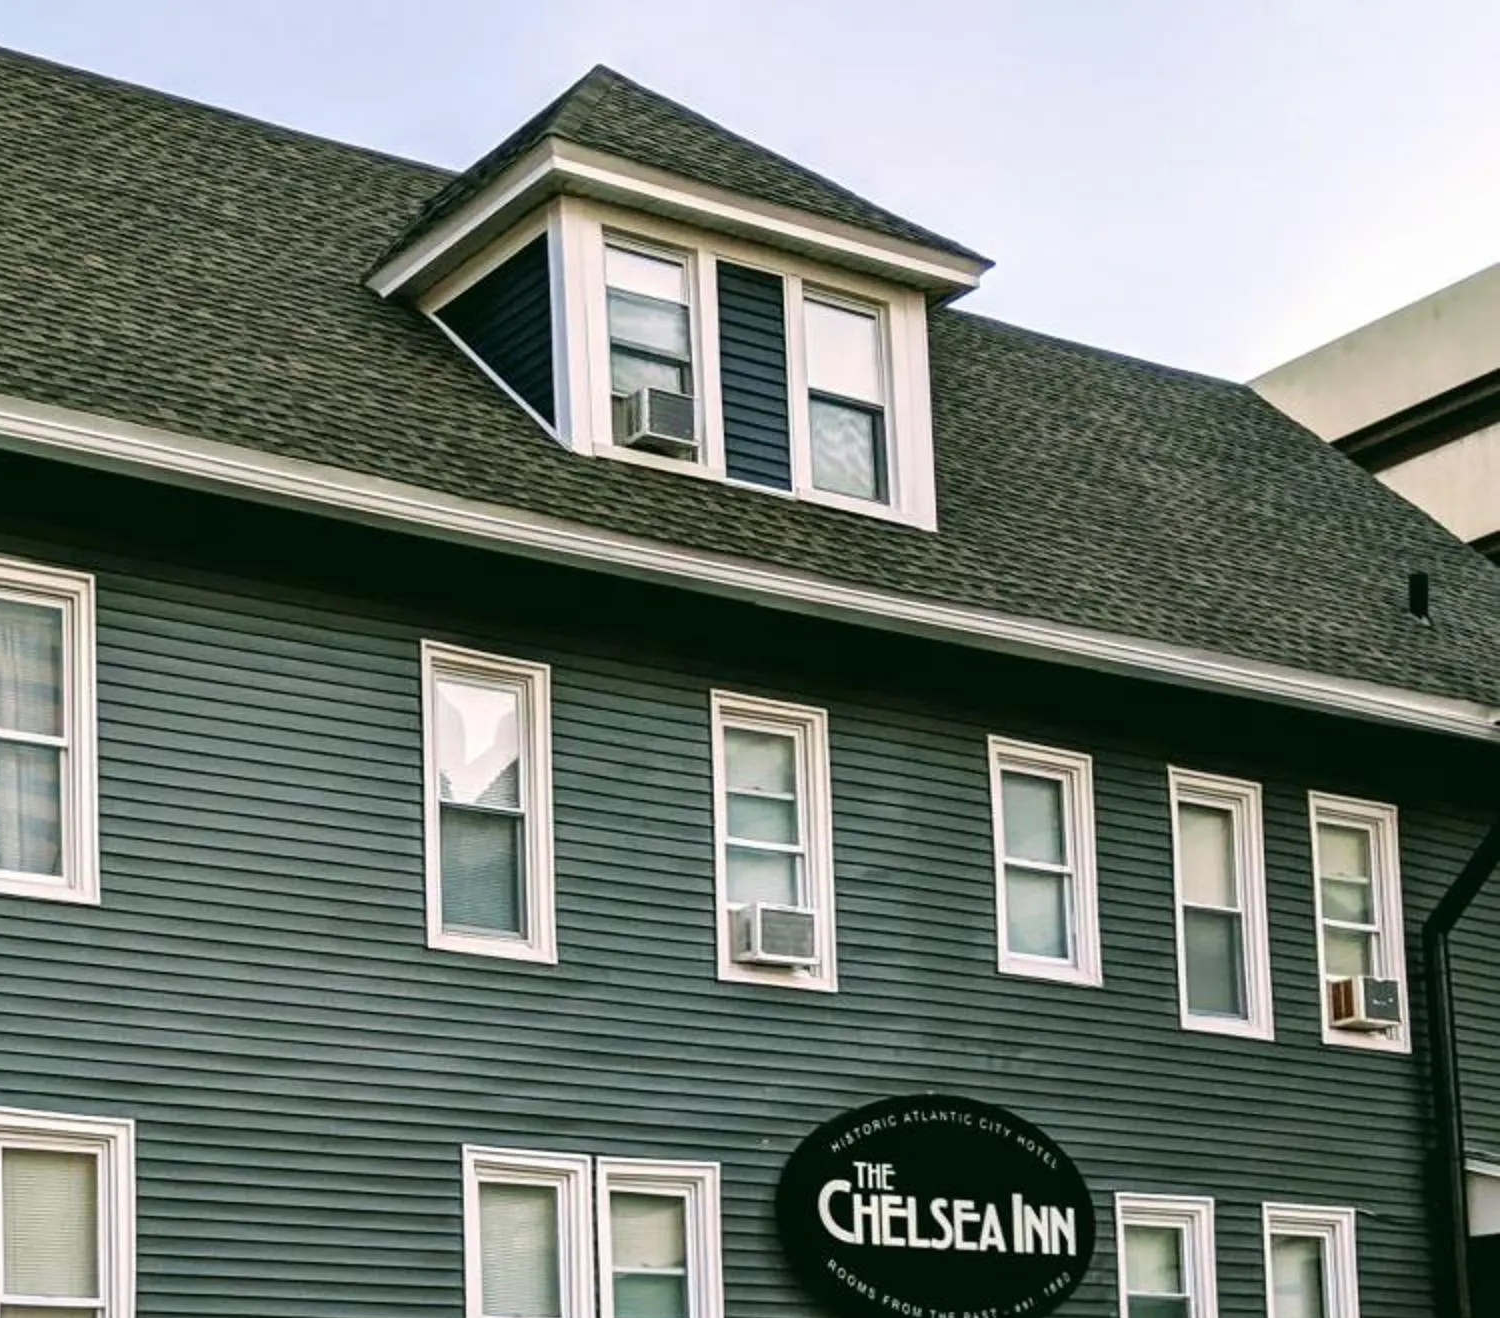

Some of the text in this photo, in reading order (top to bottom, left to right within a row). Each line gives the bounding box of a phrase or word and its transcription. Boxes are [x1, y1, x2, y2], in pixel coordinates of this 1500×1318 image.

[831, 1109, 1058, 1170] HISTORIC ATLANTIC CITY HOTEL
[852, 1161, 896, 1191] THE
[817, 1179, 1077, 1257] CHELSEA INN
[827, 1257, 877, 1301] ROOMS
[882, 1294, 923, 1318] FROM
